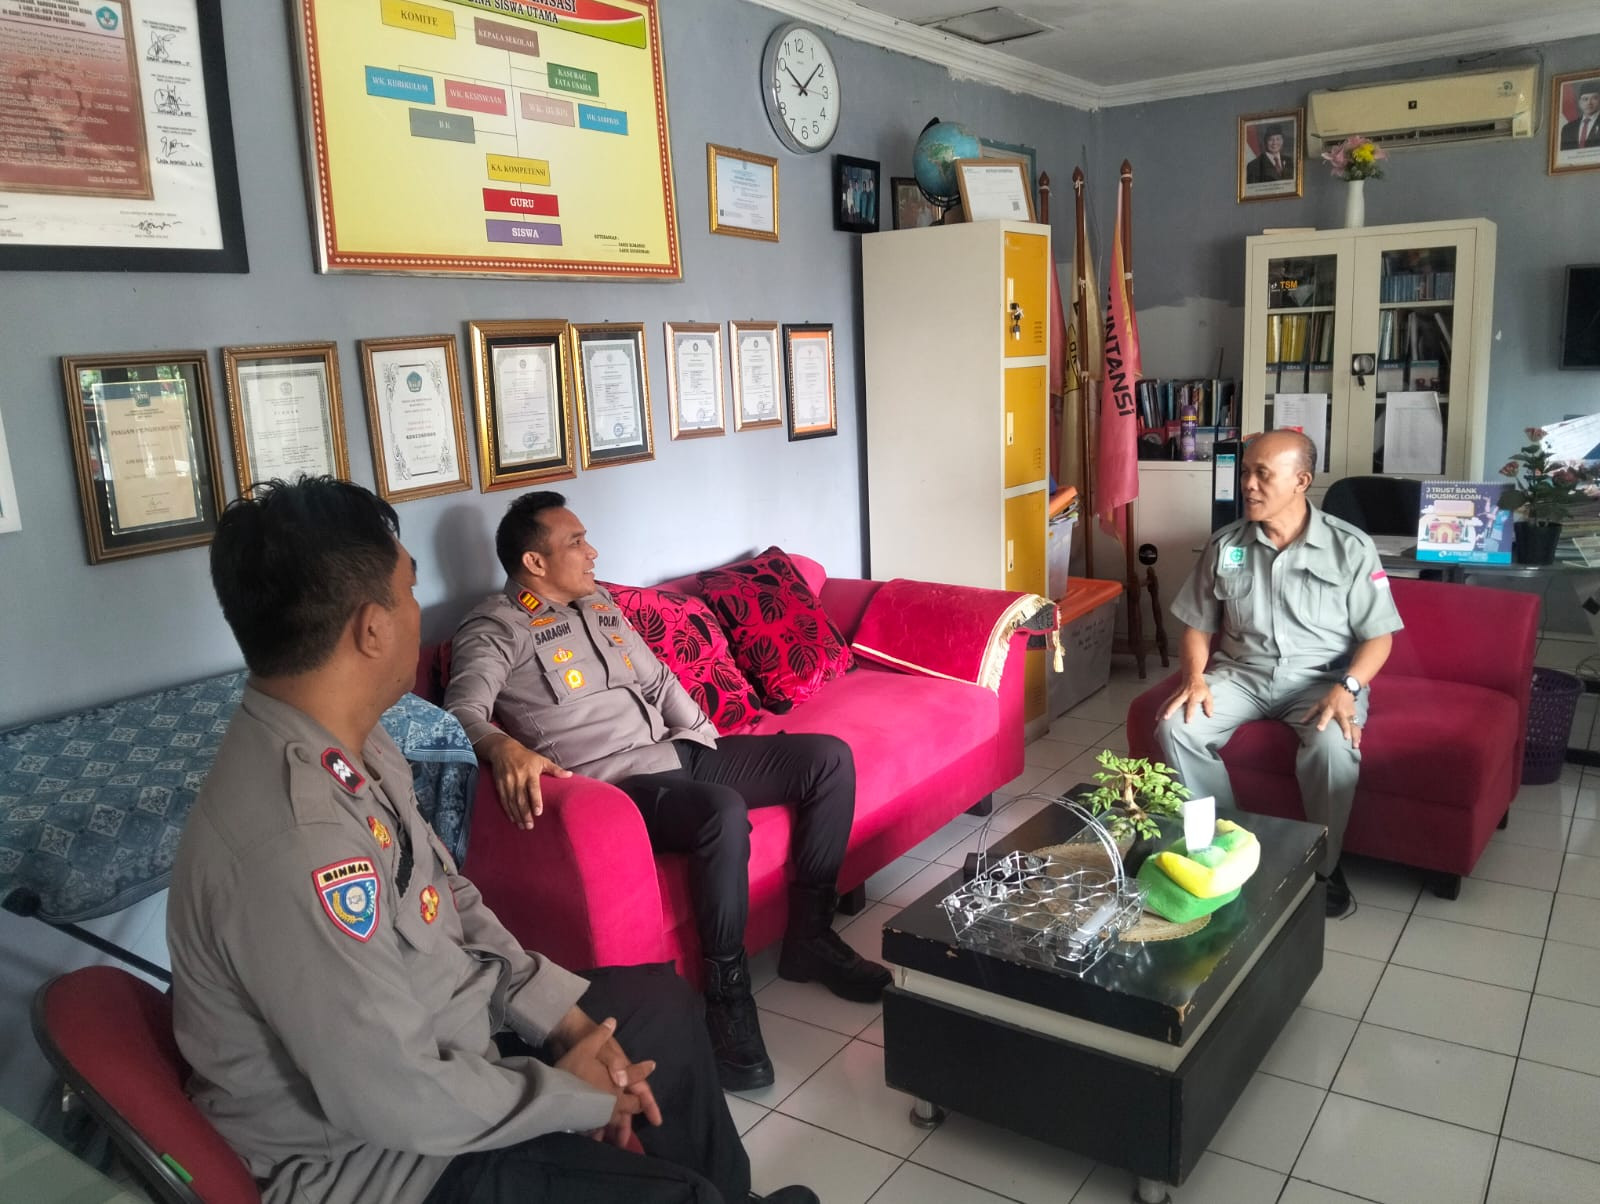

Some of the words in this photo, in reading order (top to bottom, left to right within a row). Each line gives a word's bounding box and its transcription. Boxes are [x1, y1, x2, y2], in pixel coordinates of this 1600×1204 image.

[401, 10, 438, 26] KOMITE
[526, 5, 558, 23] UTAMA
[478, 29, 504, 42] KEPALA
[504, 35, 535, 48] SEKOLAH
[795, 38, 804, 53] 12
[784, 41, 791, 56] 11
[818, 63, 824, 78] 2
[450, 88, 465, 98] WK.
[822, 85, 828, 100] 3
[779, 101, 787, 116] 8
[820, 106, 826, 120] 4
[789, 118, 796, 132] 7
[801, 125, 808, 140] 6
[812, 120, 819, 135] 5
[491, 163, 503, 172] KA.
[504, 165, 546, 177] KOMPETENSI
[509, 196, 535, 209] GURU
[511, 227, 539, 238] SISWA
[1279, 280, 1298, 289] TSM
[598, 615, 619, 628] POLRI
[534, 622, 571, 646] SARAGIH
[323, 863, 369, 882] BINMAS
